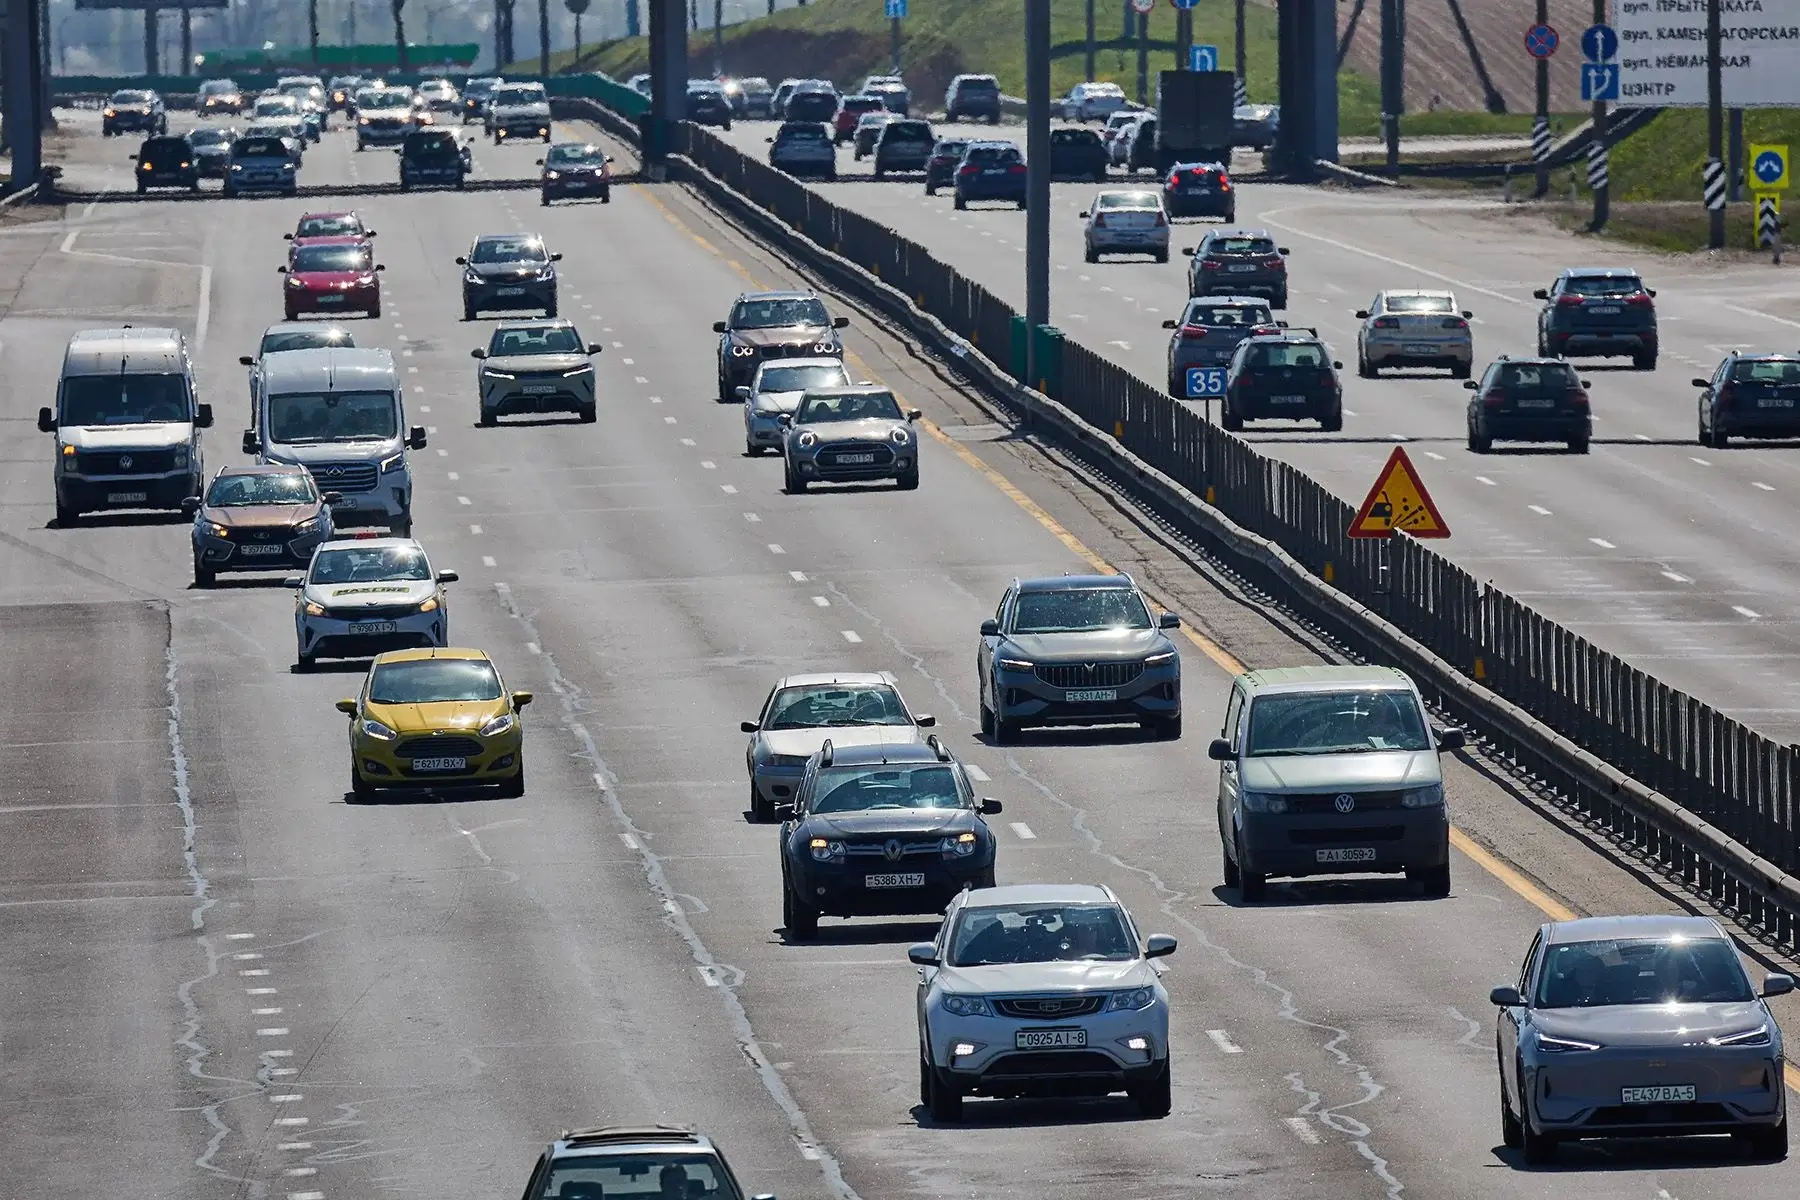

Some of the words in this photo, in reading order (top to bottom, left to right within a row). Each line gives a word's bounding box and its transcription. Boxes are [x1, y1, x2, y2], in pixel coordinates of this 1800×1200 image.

[1622, 29, 1653, 43] вул.
[1656, 26, 1799, 41] КАМЕНАГОРСКАЯ
[1621, 82, 1677, 97] ЦЭНТР
[1192, 371, 1222, 393] 35
[421, 759, 441, 768] 6217
[443, 758, 464, 768] BX-7
[874, 875, 897, 886] 5386
[898, 874, 924, 885] XH-7
[1027, 1032, 1053, 1046] 0925
[1632, 1088, 1660, 1101] E437
[1662, 1086, 1694, 1101] BA-5
